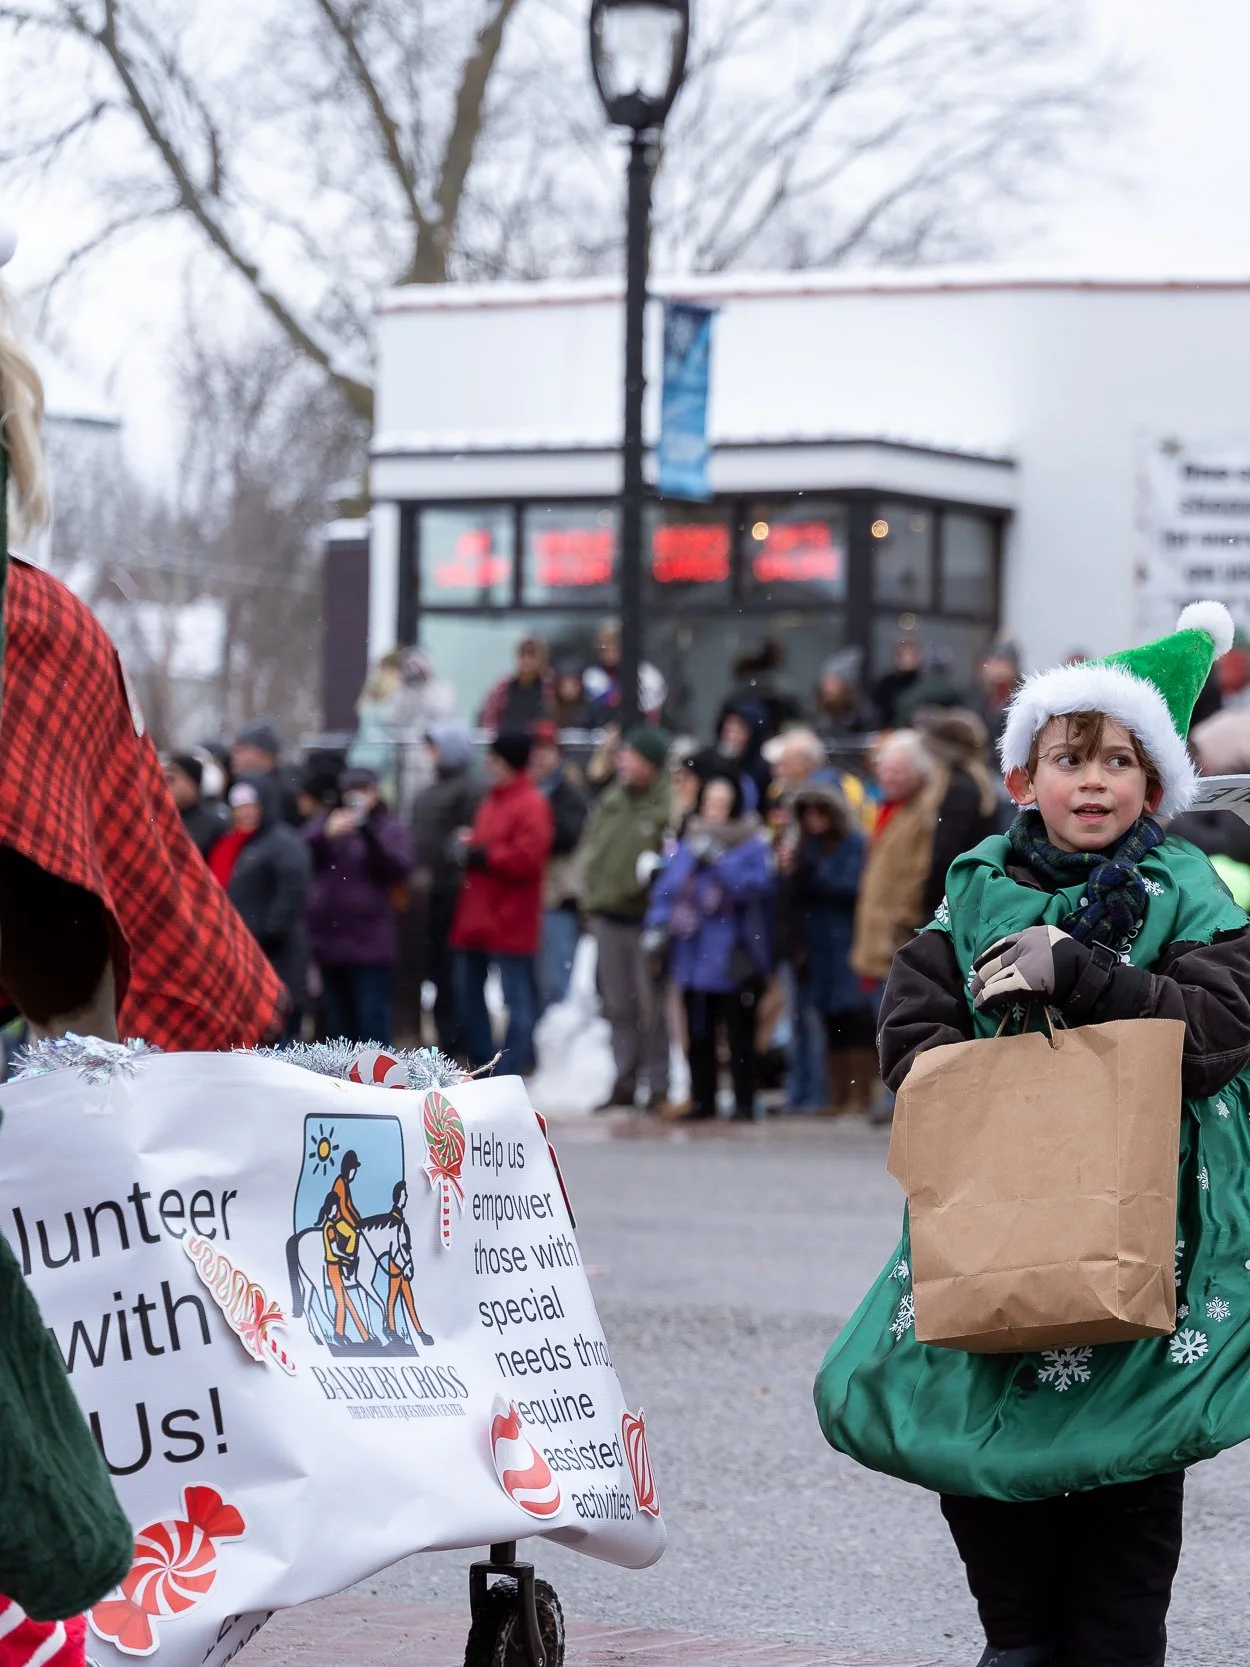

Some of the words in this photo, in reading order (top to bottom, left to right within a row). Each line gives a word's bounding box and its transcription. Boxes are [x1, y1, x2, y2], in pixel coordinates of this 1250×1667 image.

[471, 1132, 503, 1177] Help
[508, 1142, 525, 1169] us
[12, 1182, 238, 1277] lunteer
[472, 1192, 554, 1230] empower
[474, 1239, 528, 1275] those
[530, 1234, 580, 1269] with
[47, 1280, 212, 1374] with
[478, 1285, 565, 1335] special
[495, 1338, 572, 1378] needs
[573, 1333, 613, 1368] thro
[309, 1366, 407, 1400] BANBURY
[400, 1365, 469, 1399] CROSS
[89, 1387, 228, 1476] Us!
[517, 1389, 596, 1432] equine
[543, 1433, 624, 1471] assisted
[571, 1484, 634, 1521] activities.
